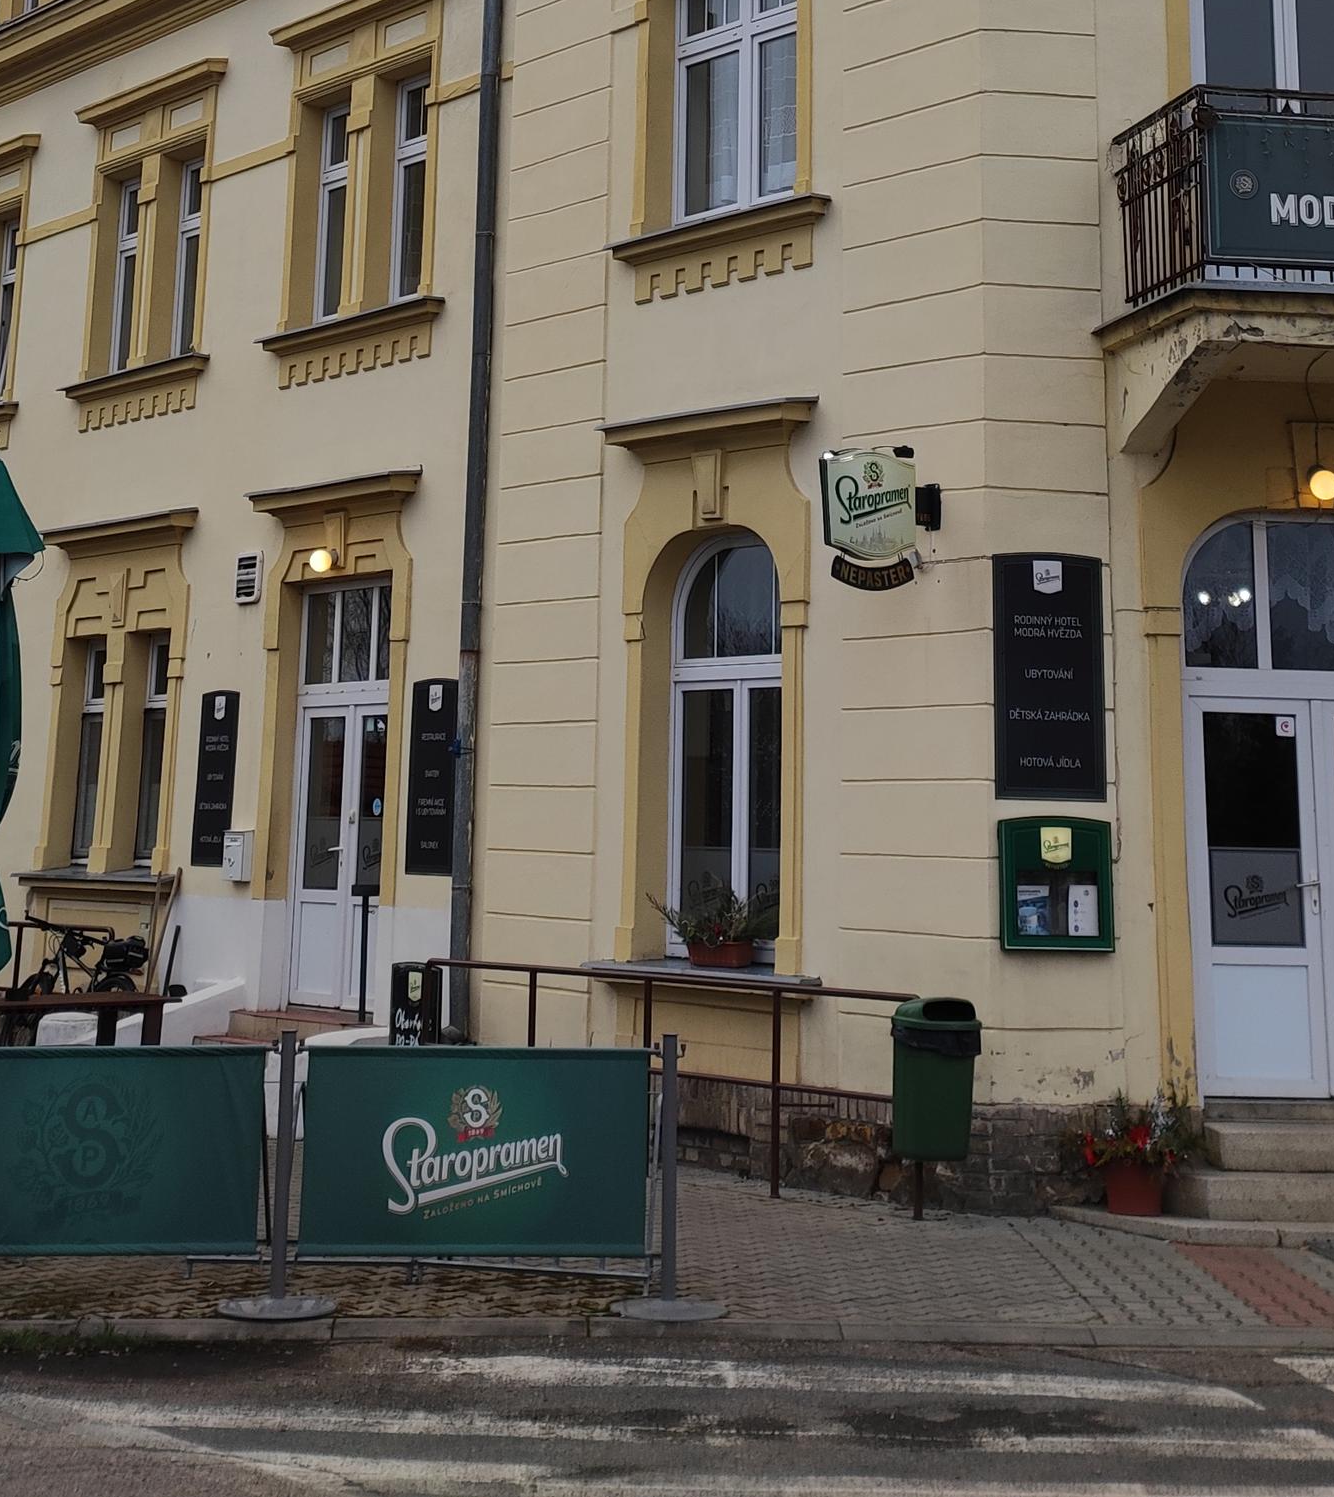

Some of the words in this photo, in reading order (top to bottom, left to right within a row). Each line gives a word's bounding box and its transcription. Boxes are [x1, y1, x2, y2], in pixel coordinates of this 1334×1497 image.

[835, 475, 912, 524] Staropramen
[839, 564, 909, 586] NEPASTER
[1014, 614, 1053, 625] RODINNÝ
[1055, 616, 1083, 627] HOTEL
[1014, 626, 1046, 637] MODRÁ
[1047, 627, 1083, 639] HVĚZDA
[1024, 668, 1074, 680] UBYTOVÁNÍ
[1009, 708, 1043, 720] DĚTSKÁ
[1044, 709, 1090, 721] ZAHRÁDKA
[1020, 756, 1054, 767] HOTOVÁ
[1055, 755, 1081, 769] JÍDLA
[382, 1117, 568, 1214] Staropramen
